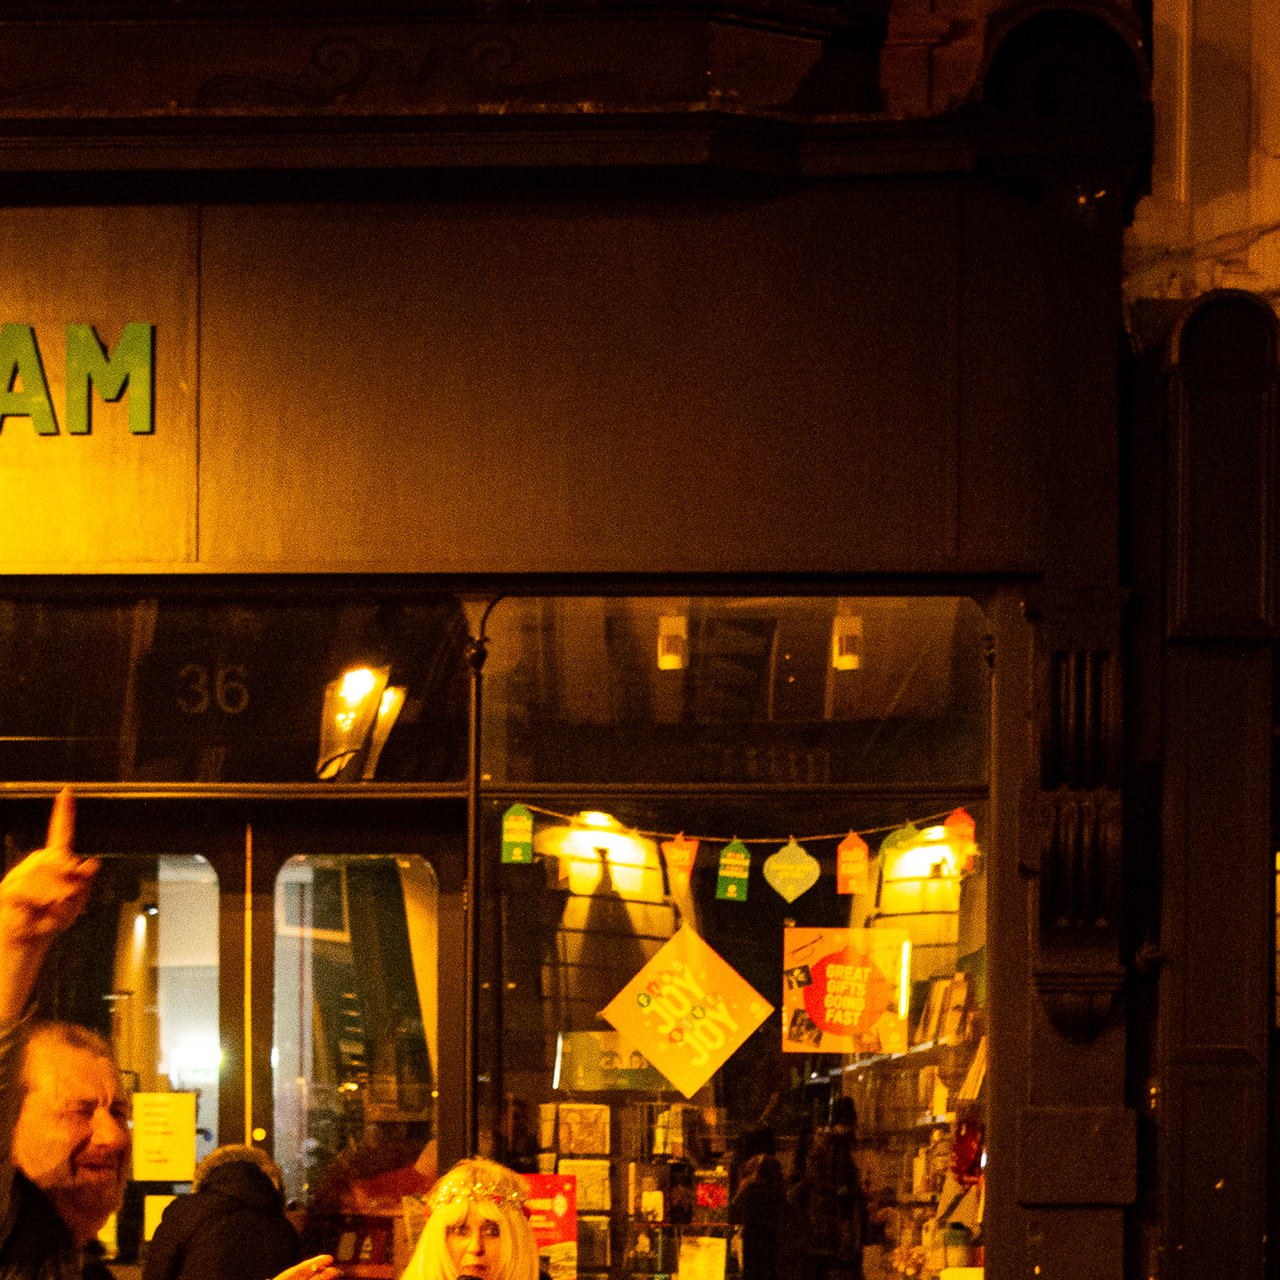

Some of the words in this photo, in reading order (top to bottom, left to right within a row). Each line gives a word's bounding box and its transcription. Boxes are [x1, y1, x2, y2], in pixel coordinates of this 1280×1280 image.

[179, 663, 249, 714] 36
[825, 963, 872, 982] GREAT
[826, 979, 867, 997] GIFTS
[642, 964, 706, 1035] JOY
[823, 993, 866, 1012] GOING
[824, 1008, 862, 1027] FAST
[677, 1000, 739, 1067] JOY
